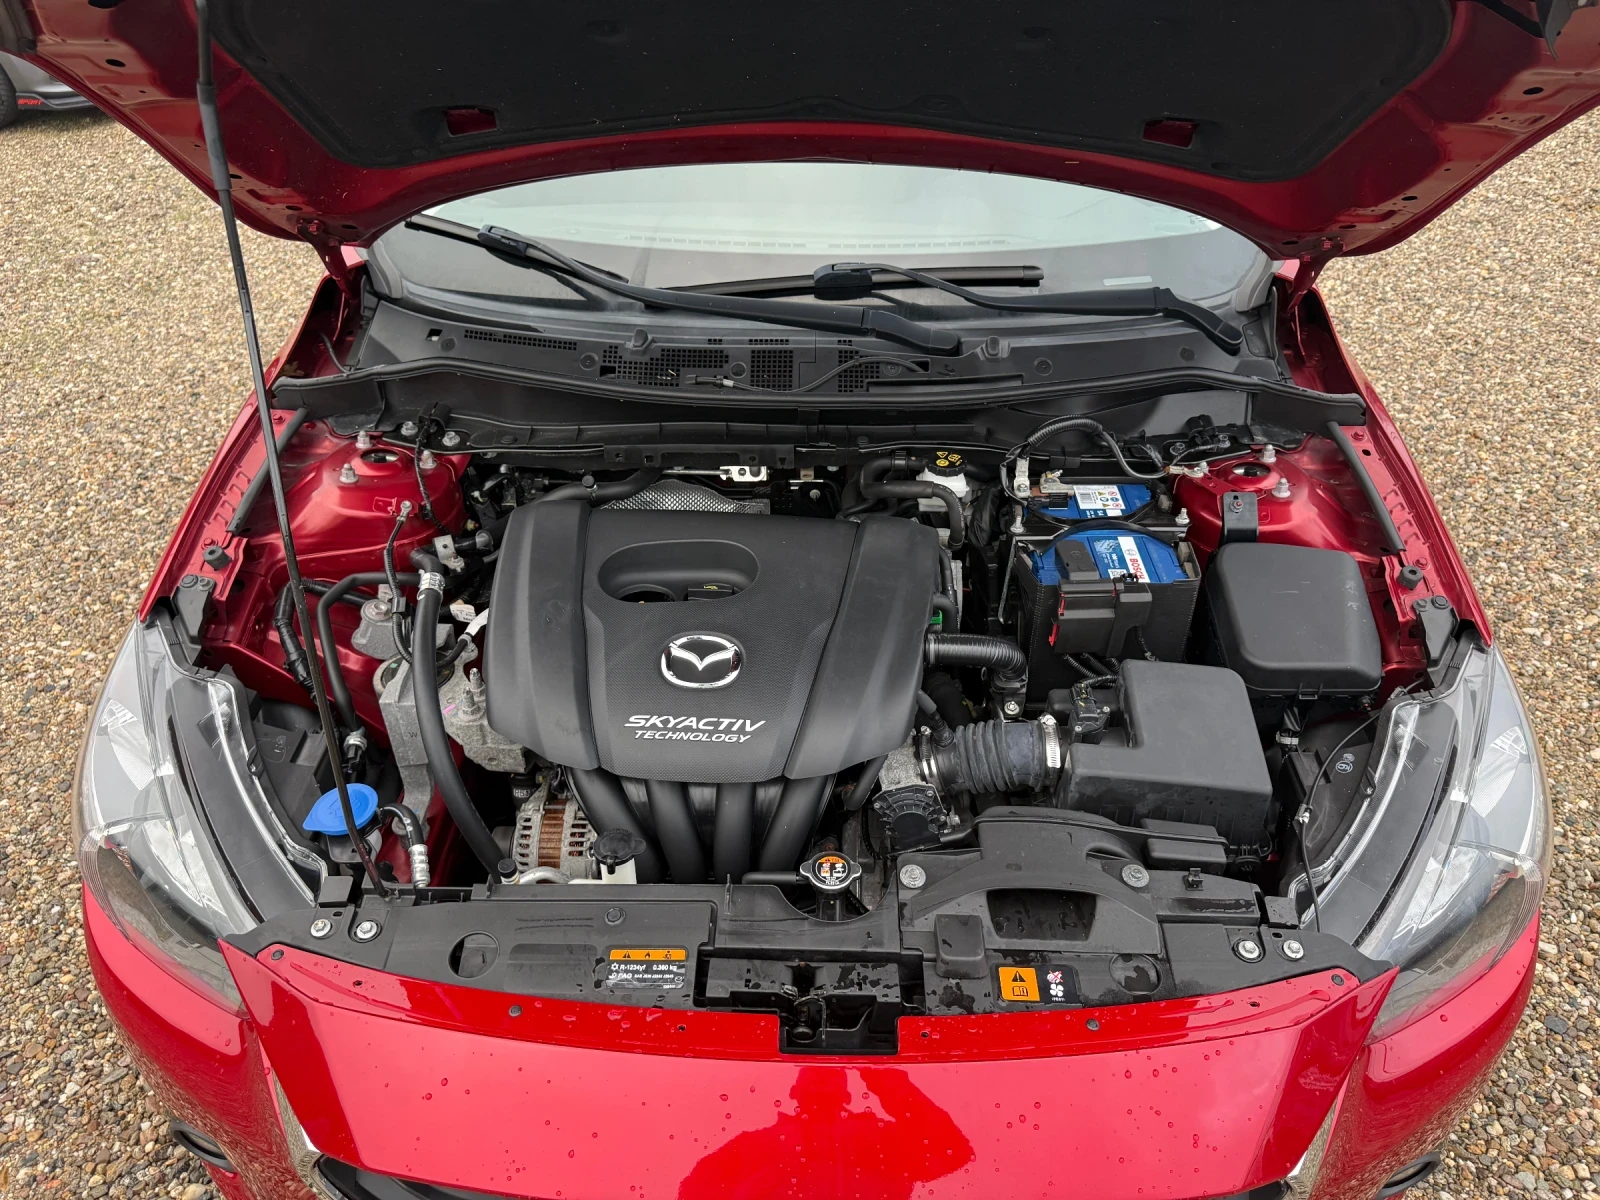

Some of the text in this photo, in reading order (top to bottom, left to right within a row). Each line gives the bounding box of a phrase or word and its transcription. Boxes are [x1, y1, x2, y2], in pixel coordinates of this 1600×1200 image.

[1129, 558, 1146, 580] BOSCH
[624, 714, 766, 732] SKYACTIV
[634, 730, 752, 743] TECHNOLOGY
[619, 964, 647, 972] R-1234yf
[669, 964, 678, 972] kg
